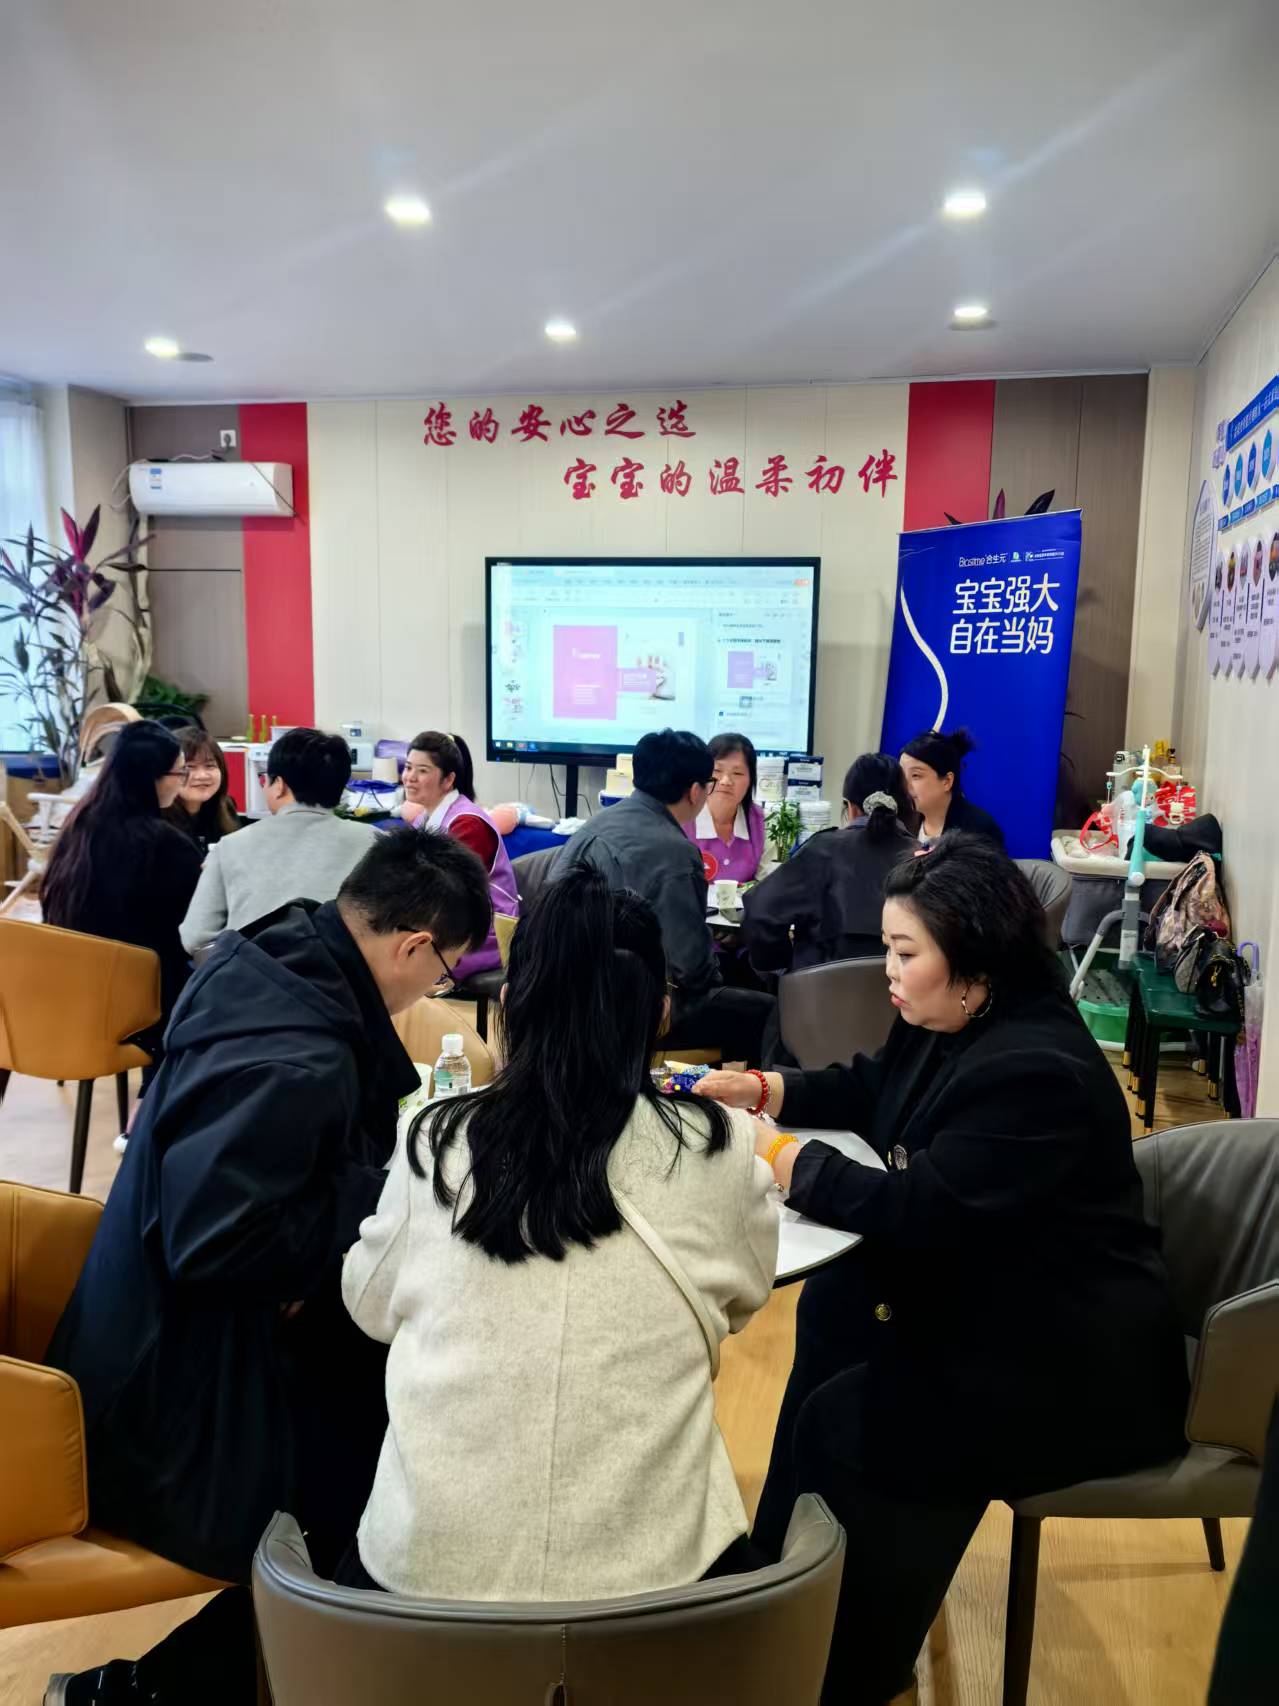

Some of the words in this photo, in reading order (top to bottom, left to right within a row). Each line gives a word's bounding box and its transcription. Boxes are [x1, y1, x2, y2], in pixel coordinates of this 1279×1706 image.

[423, 400, 696, 447] 您的安心之选
[564, 448, 898, 500] 宝宝的温柔初伴
[952, 572, 1061, 614] 宝宝强大
[949, 615, 1054, 655] 自在当妈
